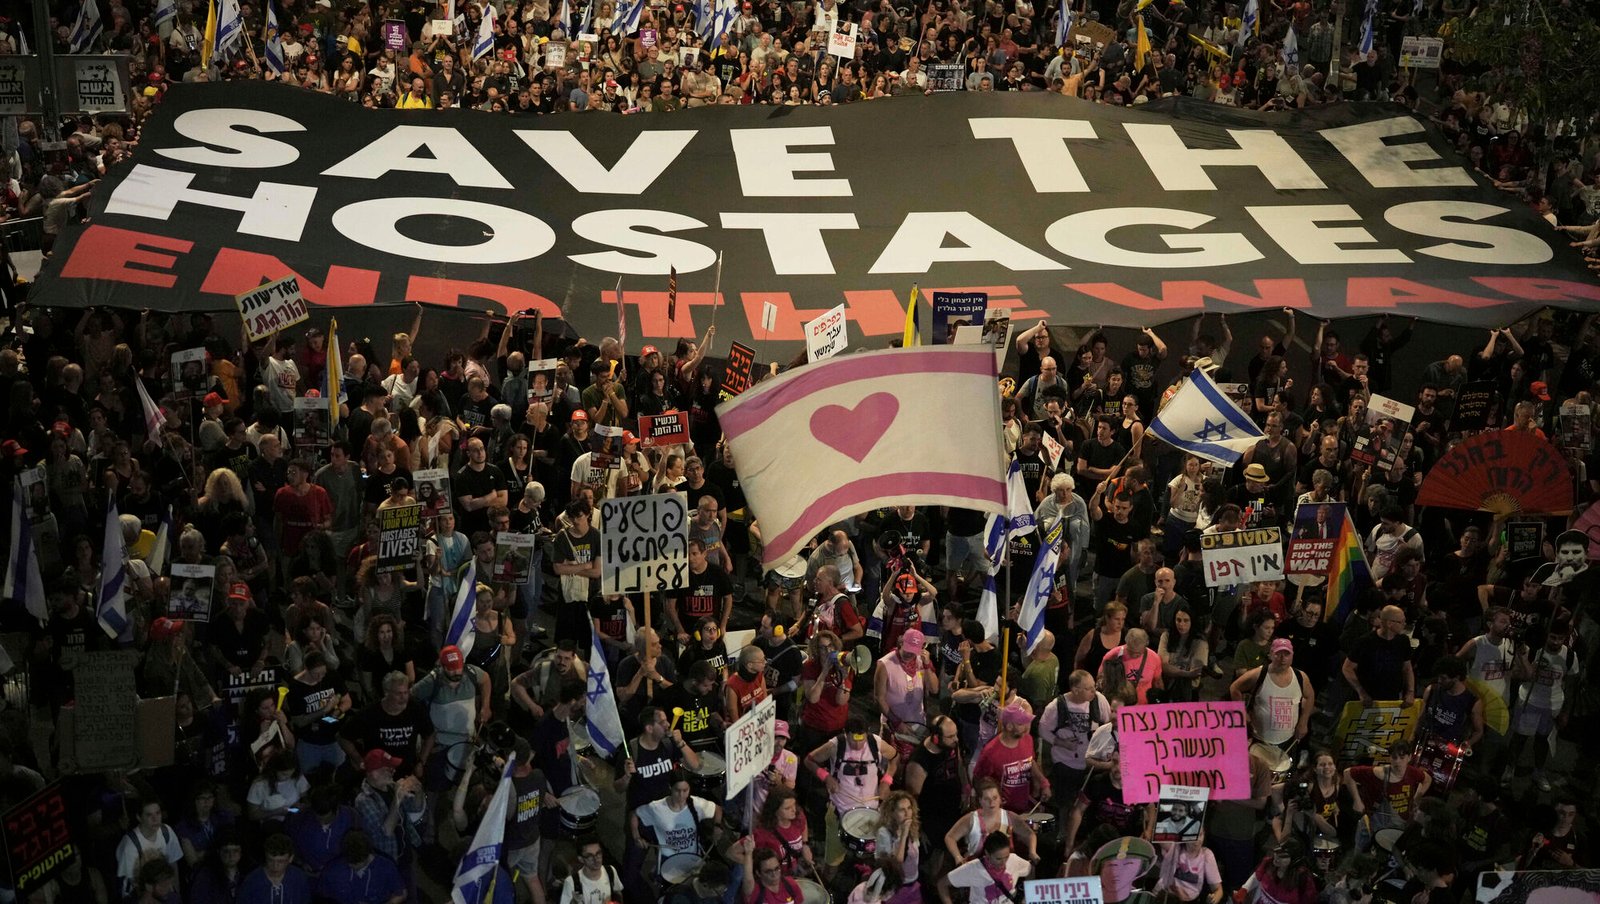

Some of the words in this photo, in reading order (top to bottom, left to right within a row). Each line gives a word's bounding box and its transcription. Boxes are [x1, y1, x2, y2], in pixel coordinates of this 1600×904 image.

[80, 82, 113, 93] אשם
[80, 96, 115, 104] במחדל
[153, 108, 853, 197] SAVE
[968, 116, 1478, 193] THE
[104, 164, 1554, 275] HOSTAGES
[60, 224, 562, 318] END
[602, 285, 1051, 341] THE
[1064, 276, 1600, 310] WAR
[241, 277, 300, 315] האדישות
[938, 304, 957, 312] גולדין
[730, 350, 751, 373] ביבי
[725, 368, 746, 392] בוגד
[654, 416, 677, 425] עכשיו
[674, 424, 682, 432] זה
[383, 518, 400, 529] YOUR
[384, 509, 396, 519] THE
[396, 507, 411, 518] COST
[412, 506, 420, 515] OF
[602, 497, 684, 532] פושעים
[379, 538, 418, 559] LIVES!
[606, 533, 687, 563] השתלטו
[1293, 543, 1312, 551] END
[1313, 542, 1333, 550] THIS
[1209, 557, 1244, 581] זמן
[1250, 552, 1280, 576] אין
[1289, 559, 1329, 572] WAR
[614, 562, 687, 592] עלינו
[683, 707, 709, 721] SEAL
[1121, 711, 1157, 732] נצח
[1163, 703, 1245, 731] במלחמת
[683, 722, 708, 732] DEAL
[1145, 732, 1168, 765] לך
[1172, 737, 1225, 758] תעשה
[638, 757, 672, 779] חופשי
[9, 795, 64, 835] ביבי
[14, 819, 69, 862] בוגד
[18, 844, 72, 889] בחטופים
[1035, 884, 1061, 900] וזיני
[1064, 882, 1090, 898] ביבי
